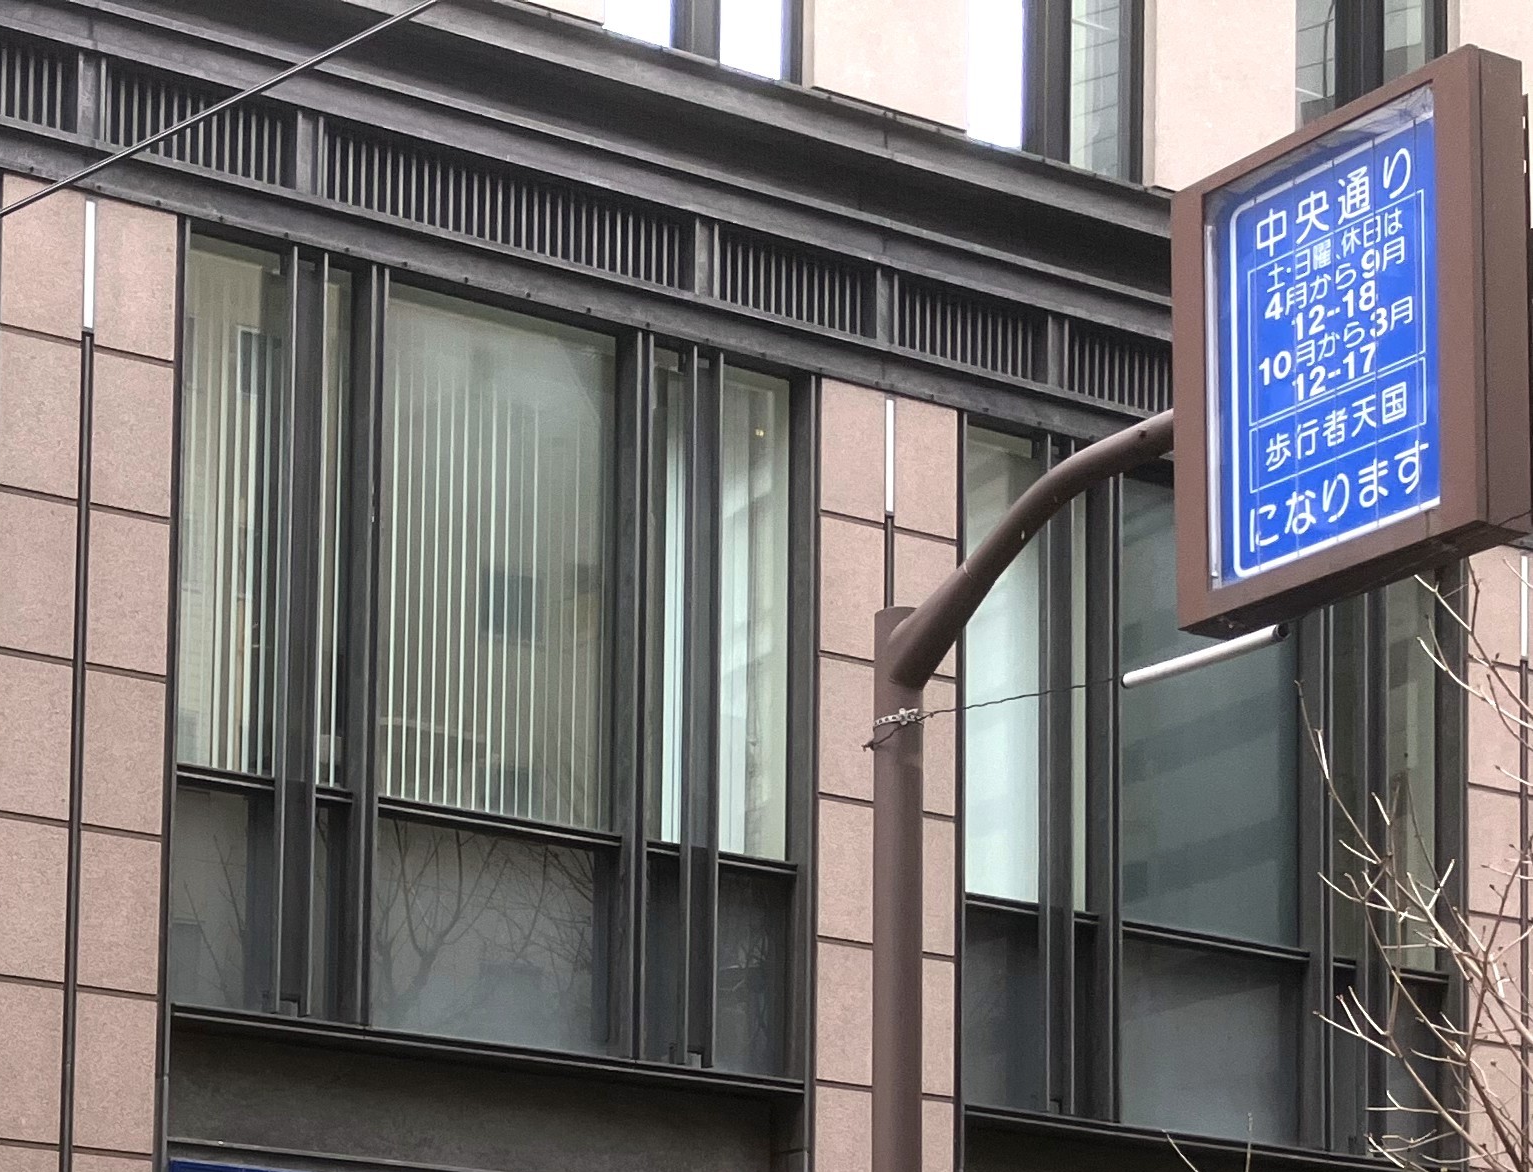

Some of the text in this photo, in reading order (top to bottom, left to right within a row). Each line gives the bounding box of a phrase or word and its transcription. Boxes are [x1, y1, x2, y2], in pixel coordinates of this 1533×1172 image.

[1256, 147, 1412, 257] 中央通り
[1265, 237, 1407, 321] 4月から9月
[1258, 296, 1414, 386] 10月から3月
[1265, 382, 1408, 472] 歩行者天国
[1249, 440, 1430, 552] になります
